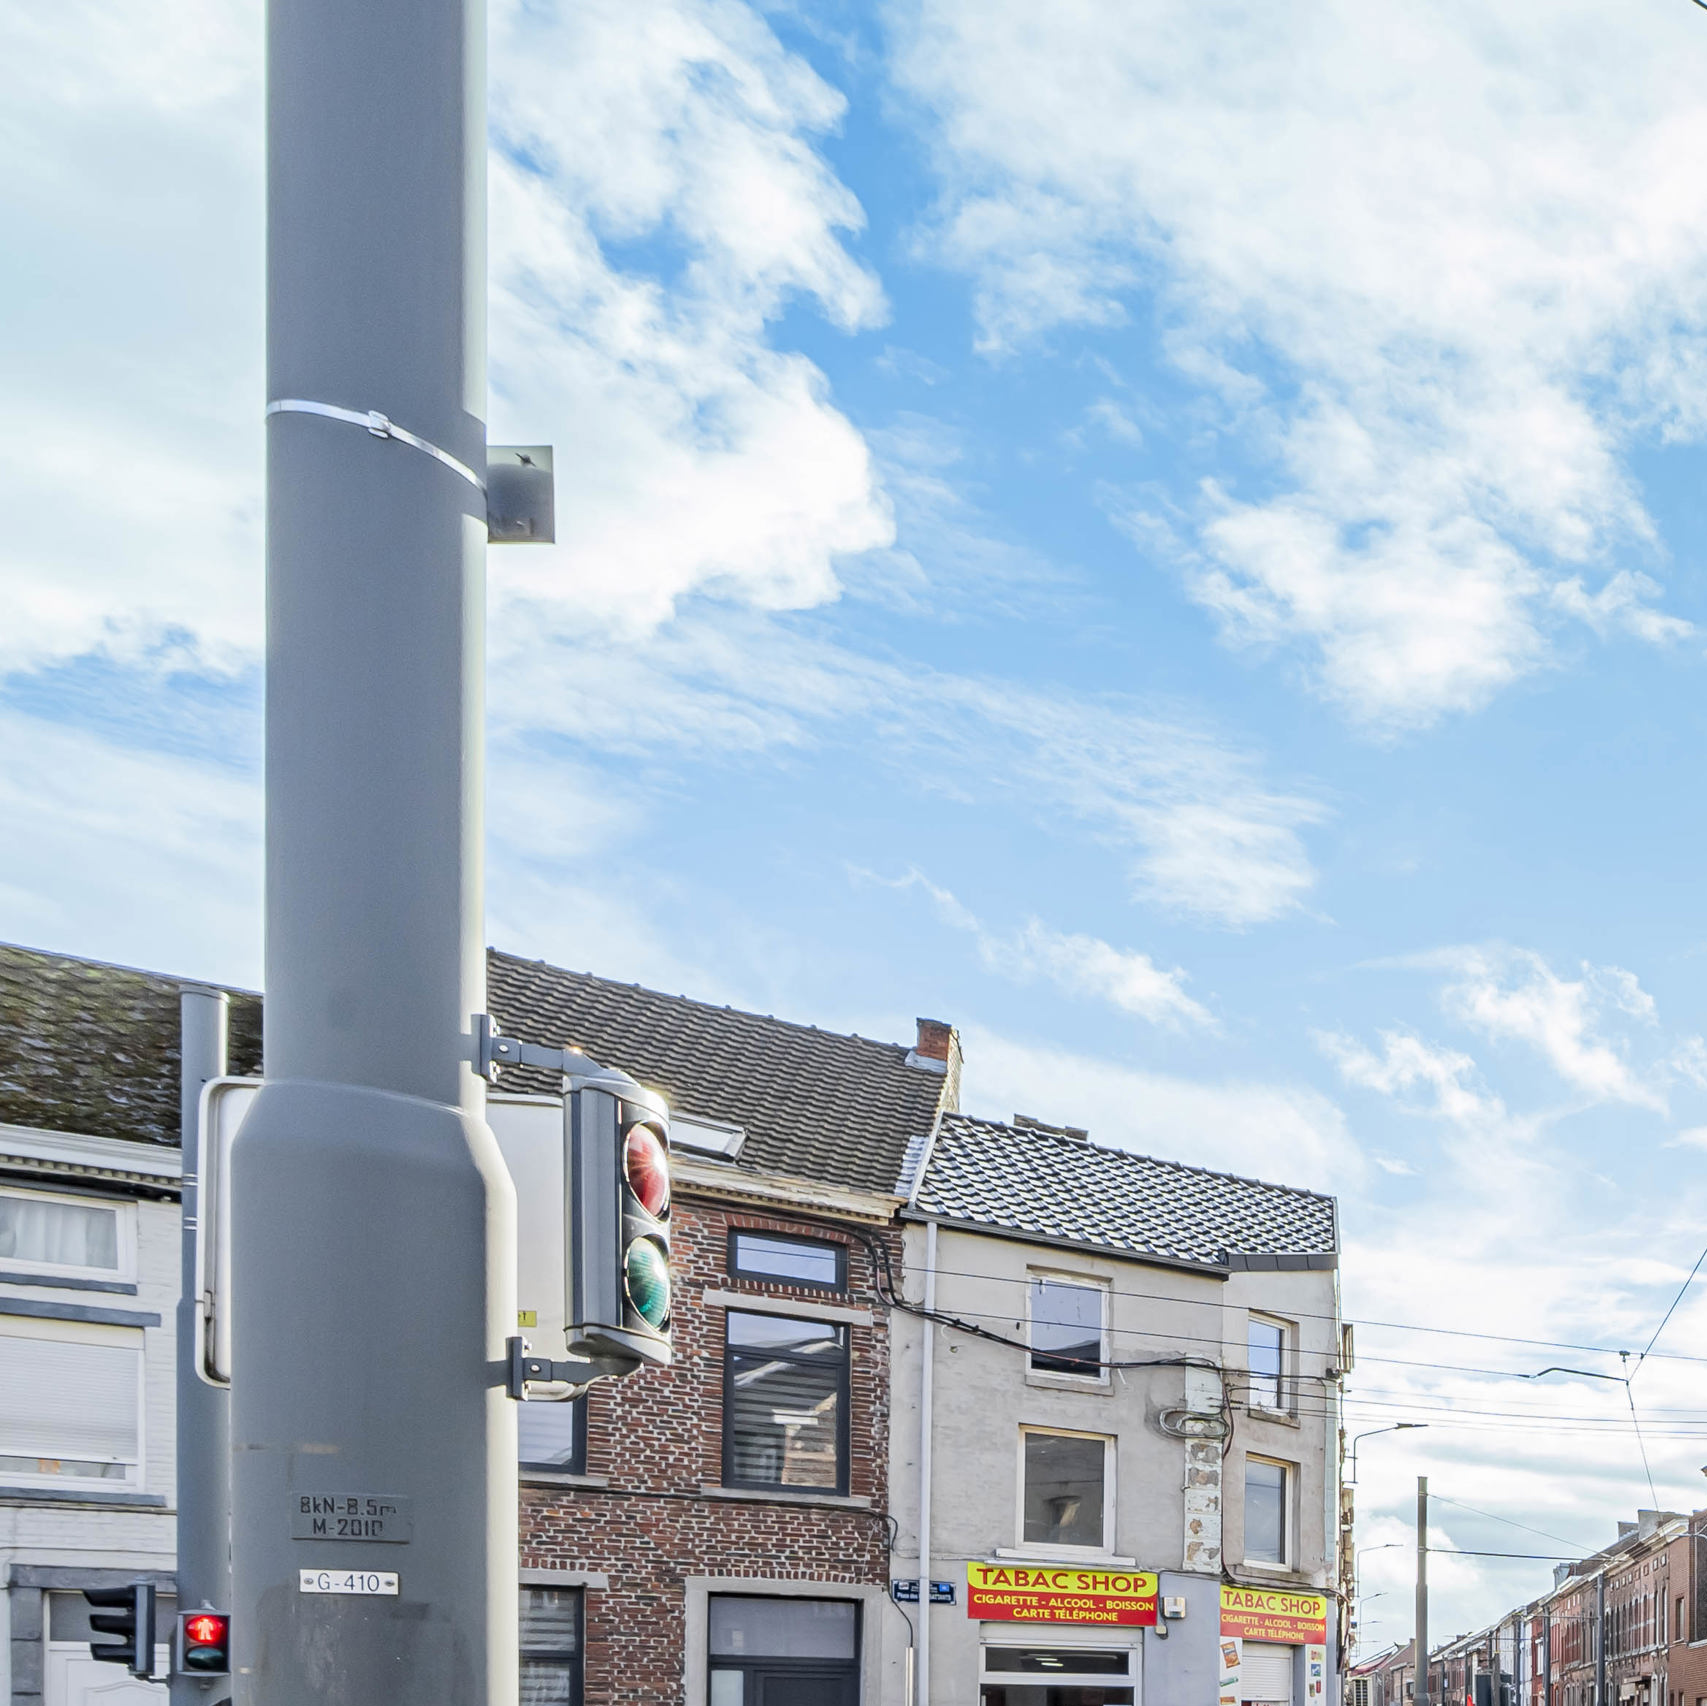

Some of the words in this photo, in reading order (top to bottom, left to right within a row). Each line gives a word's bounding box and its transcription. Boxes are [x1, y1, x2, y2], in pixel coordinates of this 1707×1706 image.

[313, 1518, 383, 1536] M-2010
[317, 1572, 380, 1592] G-410
[976, 1568, 1069, 1590] TABAC
[1077, 1573, 1147, 1593] SHOP
[973, 1594, 1038, 1606] CIGARETTE
[1048, 1598, 1096, 1609] ALCOOL
[1106, 1600, 1154, 1611] BOISSON
[1223, 1590, 1276, 1611] TABAC
[1280, 1597, 1321, 1616] SHOP
[1012, 1608, 1051, 1619] CARTE
[1054, 1608, 1118, 1621] TÉLÉPHONE
[1221, 1614, 1259, 1626] CIGARETTE
[1264, 1619, 1292, 1629] ALCOOL
[1297, 1621, 1325, 1632] BOISSON
[1243, 1627, 1266, 1638] CARTE
[1267, 1628, 1305, 1640] TÉLÉPHONE
